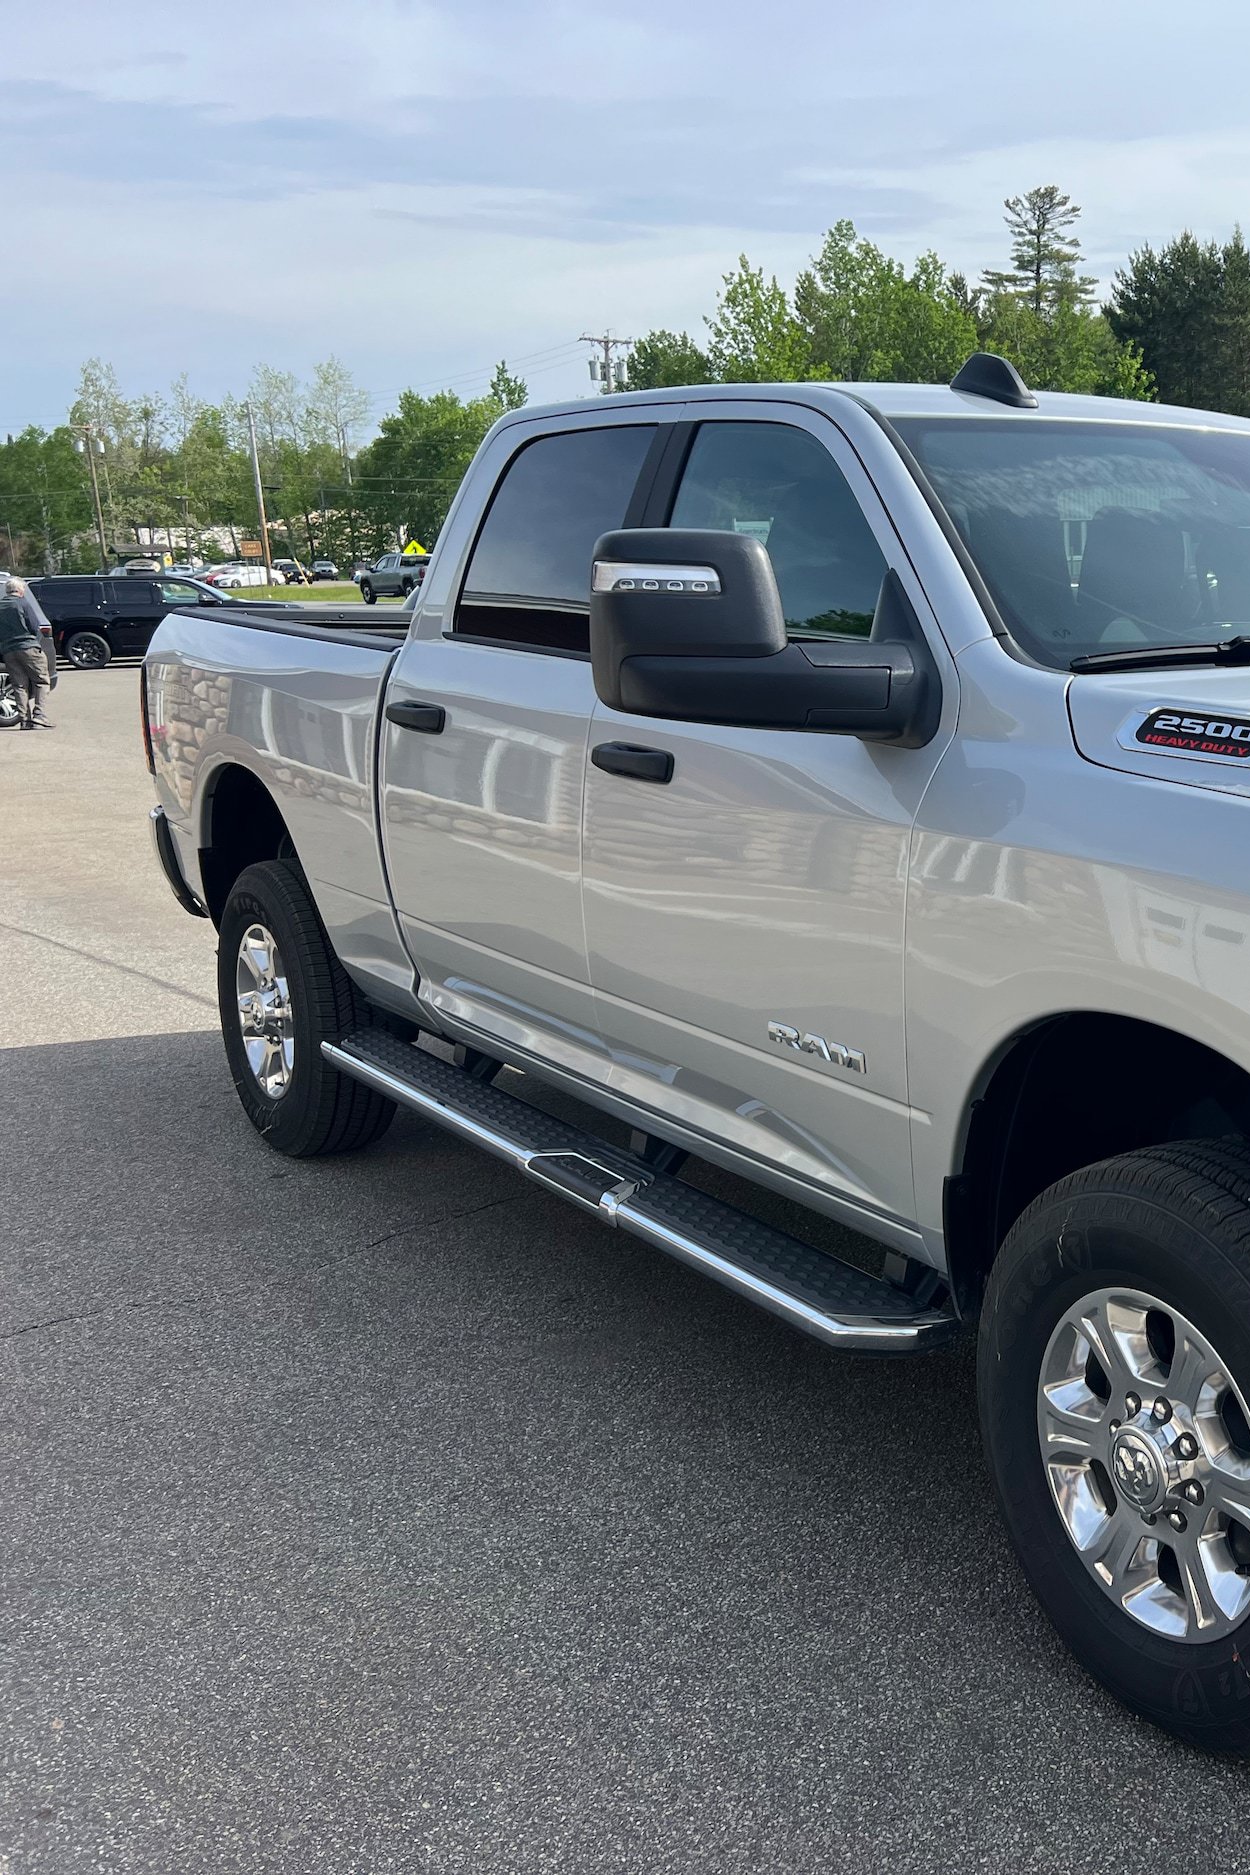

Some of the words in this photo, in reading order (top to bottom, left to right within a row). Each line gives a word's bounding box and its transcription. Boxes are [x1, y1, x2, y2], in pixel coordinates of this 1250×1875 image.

[1144, 734, 1201, 750] HEAVY
[1200, 741, 1250, 756] DUTY
[767, 1020, 867, 1074] RAM
